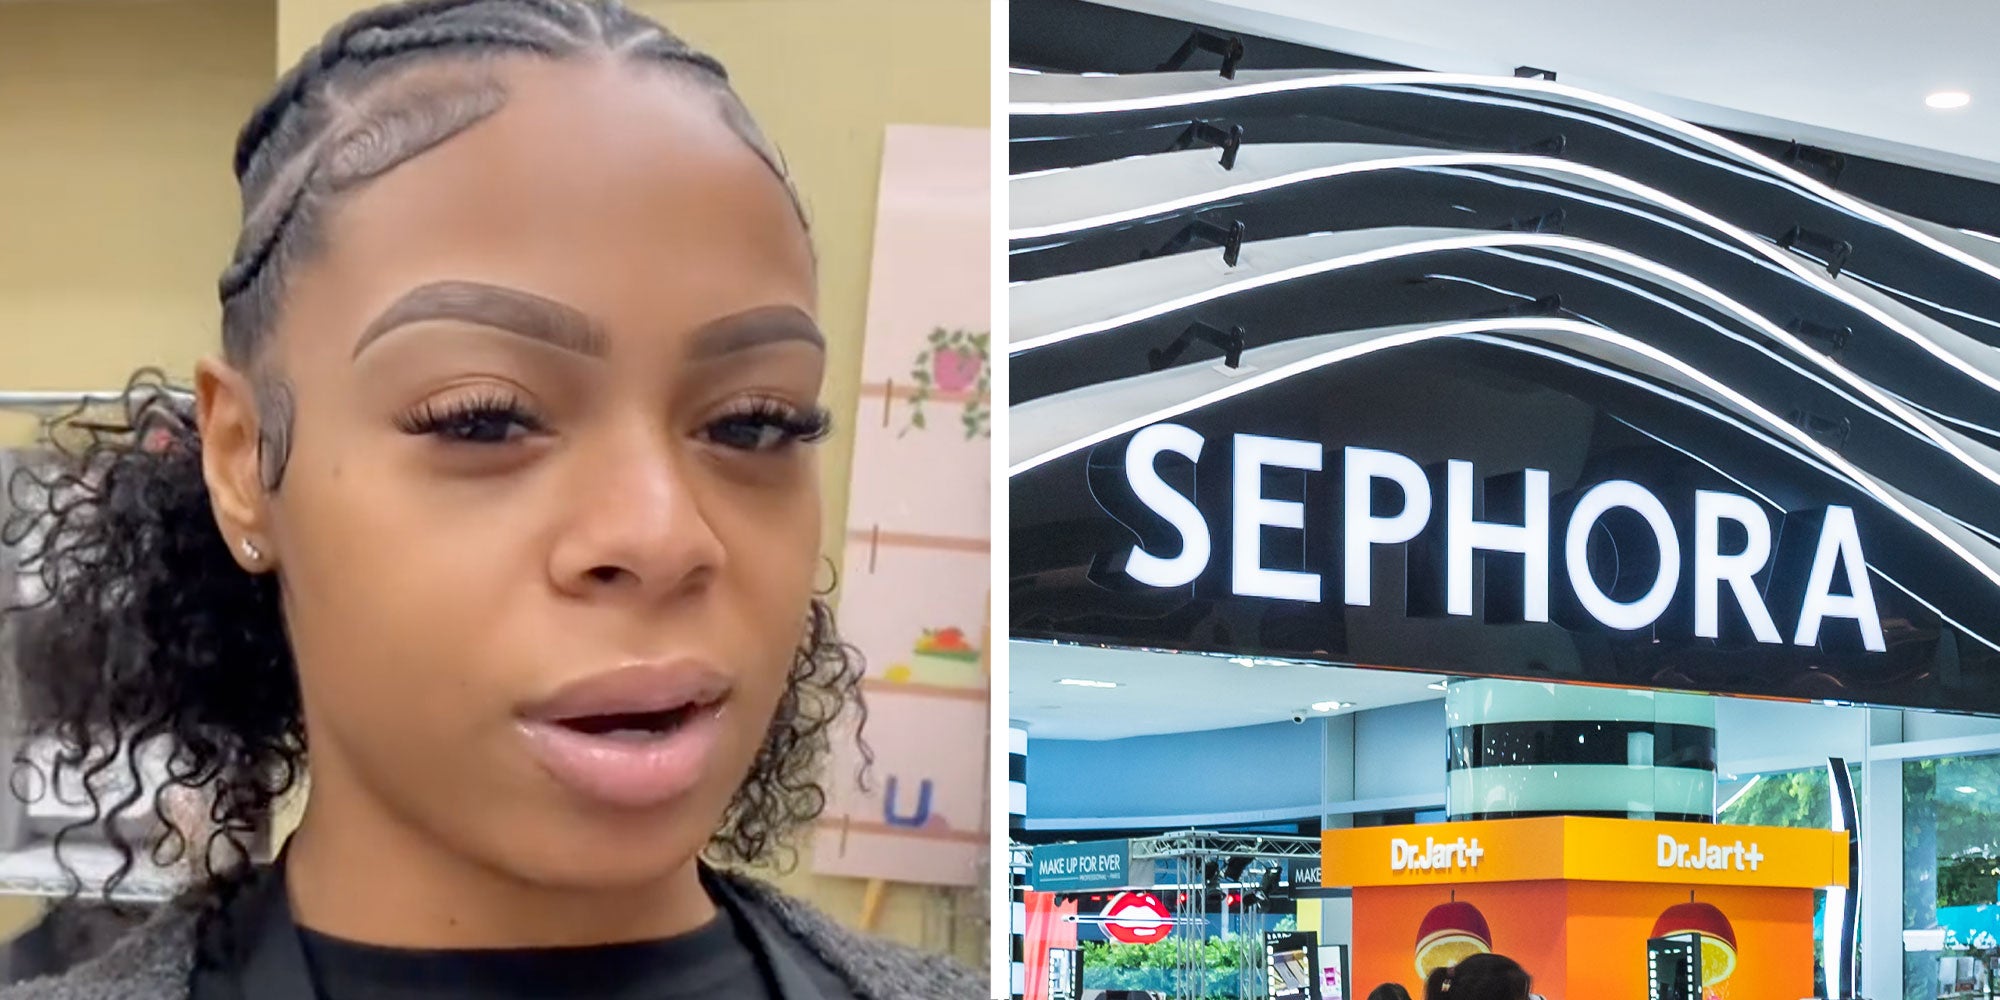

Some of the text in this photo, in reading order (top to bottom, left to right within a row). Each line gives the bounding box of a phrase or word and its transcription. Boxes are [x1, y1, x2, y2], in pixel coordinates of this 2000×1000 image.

[1125, 423, 1887, 652] SEPHORA
[1039, 854, 1120, 875] MAKE UP FOR EVER
[1391, 836, 1484, 870] Dr.Jart+
[1657, 833, 1764, 871] Dr.Jart+
[1295, 867, 1321, 883] MAKE
